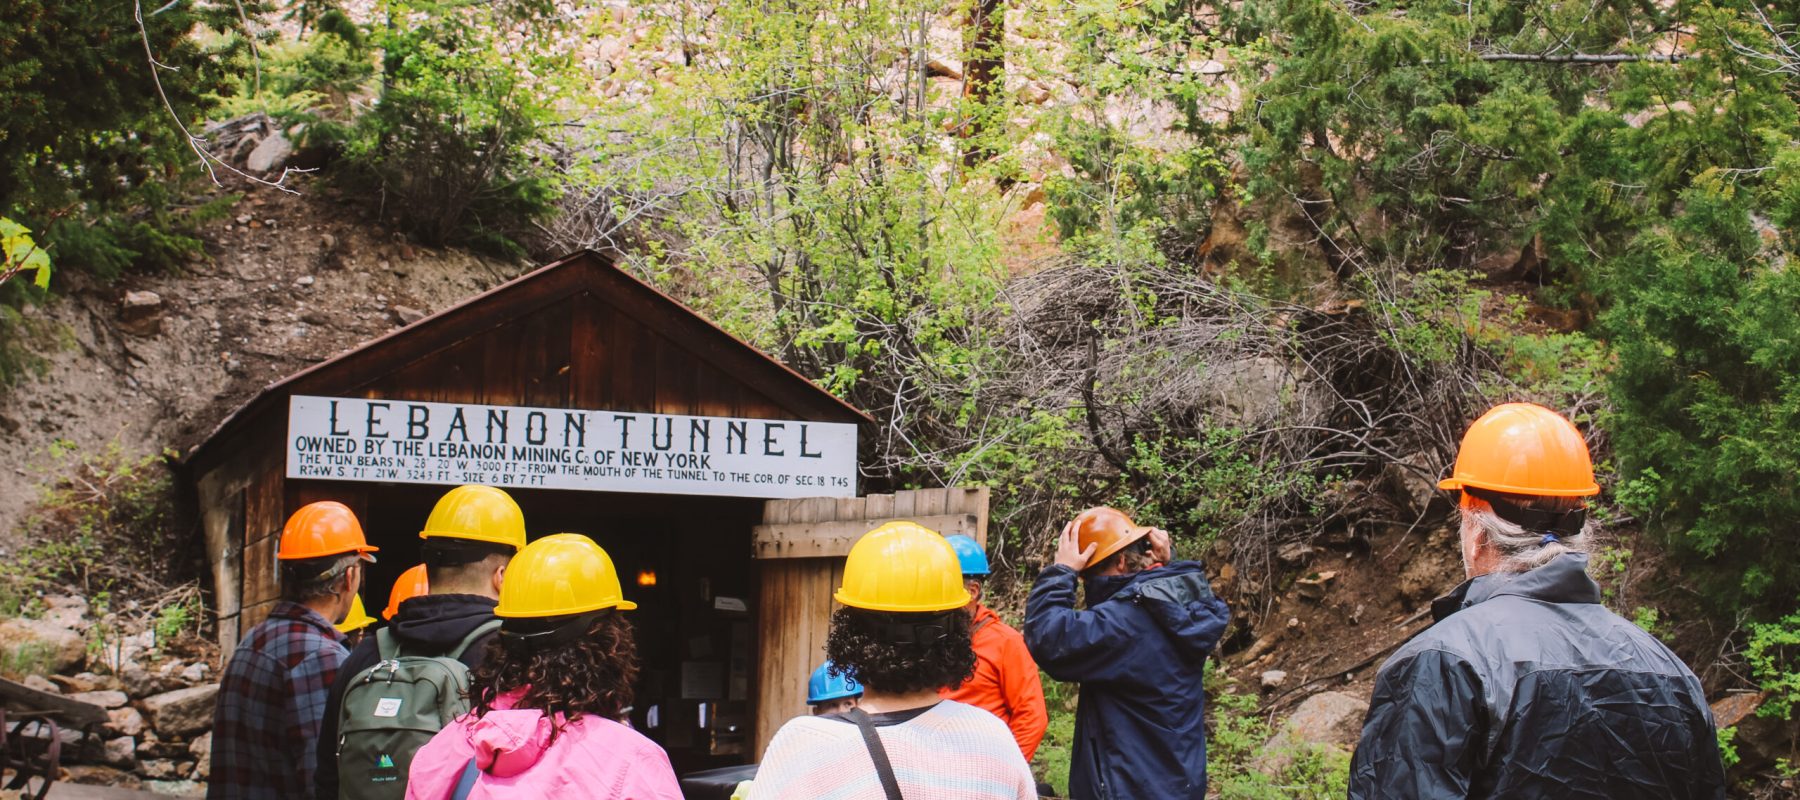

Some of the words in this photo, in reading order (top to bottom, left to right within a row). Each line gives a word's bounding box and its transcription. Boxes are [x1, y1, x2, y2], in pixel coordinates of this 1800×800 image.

[330, 401, 586, 447] LEBANON
[613, 415, 822, 458] TUNNEL
[295, 436, 357, 453] OWNED
[364, 440, 386, 455] BY
[392, 440, 423, 456] THE
[429, 442, 506, 460] LEBANON
[512, 446, 571, 463] MINING
[594, 450, 615, 465] OF
[621, 450, 659, 466] NEW
[664, 452, 711, 469] YORK
[298, 453, 321, 464] THE
[357, 456, 393, 467] BEARS
[528, 463, 556, 474] FROM
[561, 464, 580, 475] THE
[583, 466, 620, 477] MOUTH
[624, 468, 637, 478] OF
[642, 468, 662, 479] THE
[667, 469, 708, 481] TUNNEL
[712, 471, 726, 481] TO
[730, 472, 750, 483] THE
[777, 474, 790, 484] OF
[817, 476, 825, 486] 18
[830, 476, 849, 487] T4S
[462, 472, 485, 482] SIZE
[491, 473, 499, 483] 6
[503, 473, 515, 484] BY
[520, 474, 527, 484] 7
